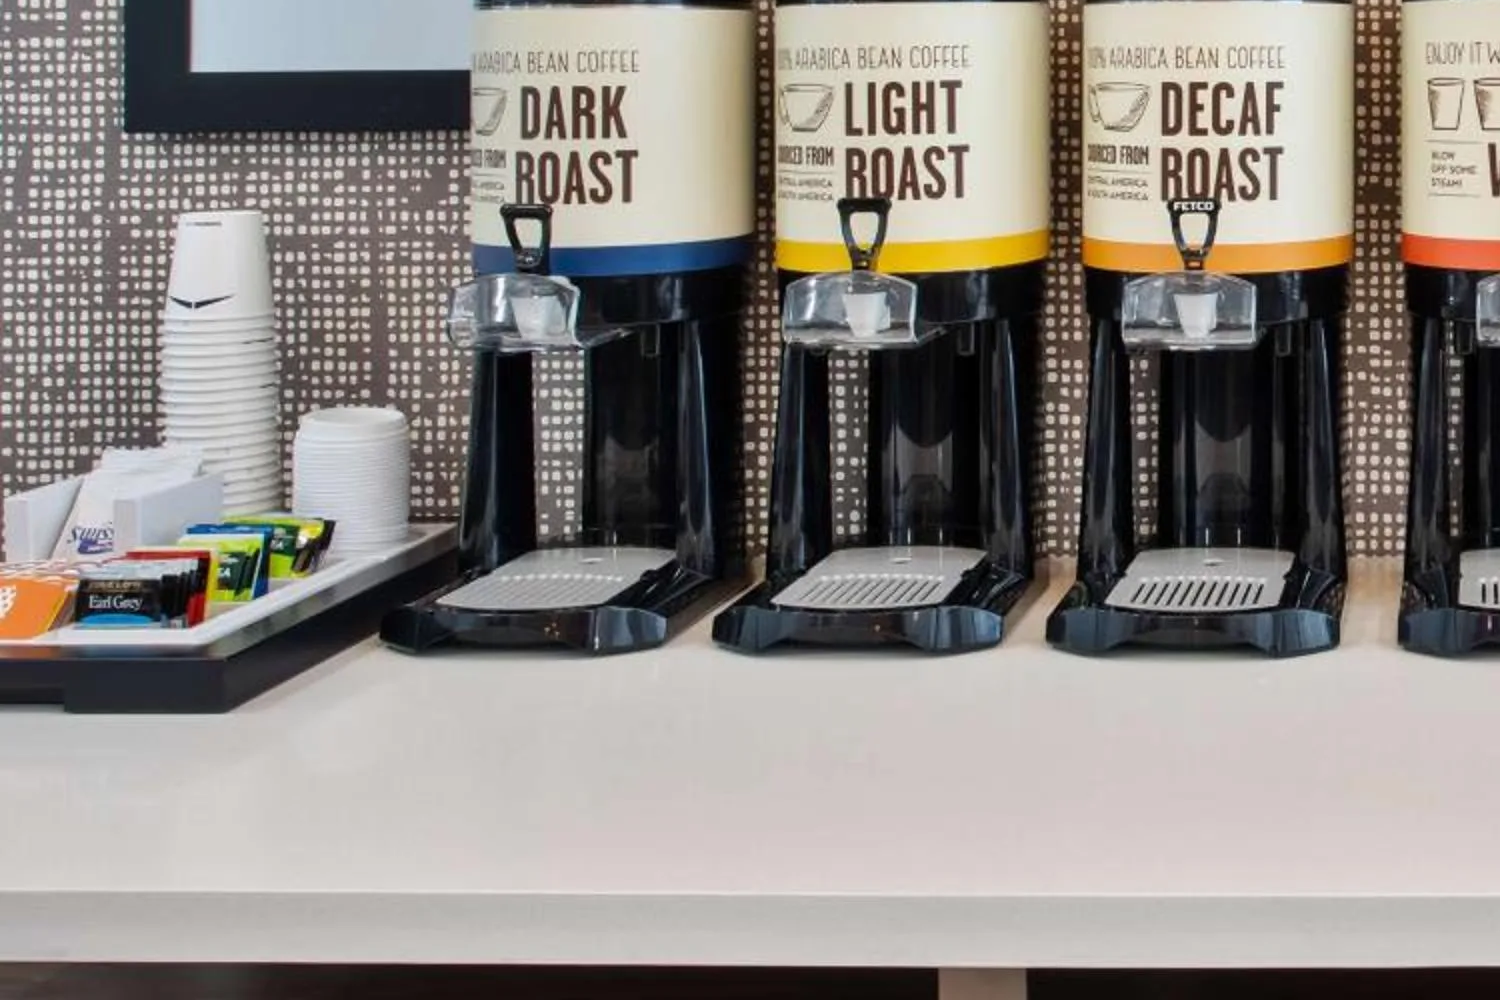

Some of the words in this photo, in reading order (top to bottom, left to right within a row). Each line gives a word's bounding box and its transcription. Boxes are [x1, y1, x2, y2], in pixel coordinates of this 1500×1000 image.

[527, 51, 569, 73] BEAN
[577, 50, 640, 73] COFFEE
[858, 46, 902, 69] BEAN
[909, 45, 970, 68] COFFEE
[1109, 46, 1168, 69] ARABICA
[1175, 46, 1219, 69] BEAN
[1227, 45, 1286, 69] COFFEE
[1426, 42, 1464, 65] ENJOY
[1469, 42, 1482, 64] IT
[520, 85, 628, 140] DARK
[845, 80, 962, 136] LIGHT
[1161, 81, 1284, 136] DECAF
[805, 146, 834, 166] FROM
[1120, 145, 1149, 165] FROM
[515, 149, 638, 204] ROAST
[845, 144, 970, 200] ROAST
[1161, 147, 1284, 202] ROAST
[89, 596, 112, 610] Earl
[113, 596, 143, 611] Grey
